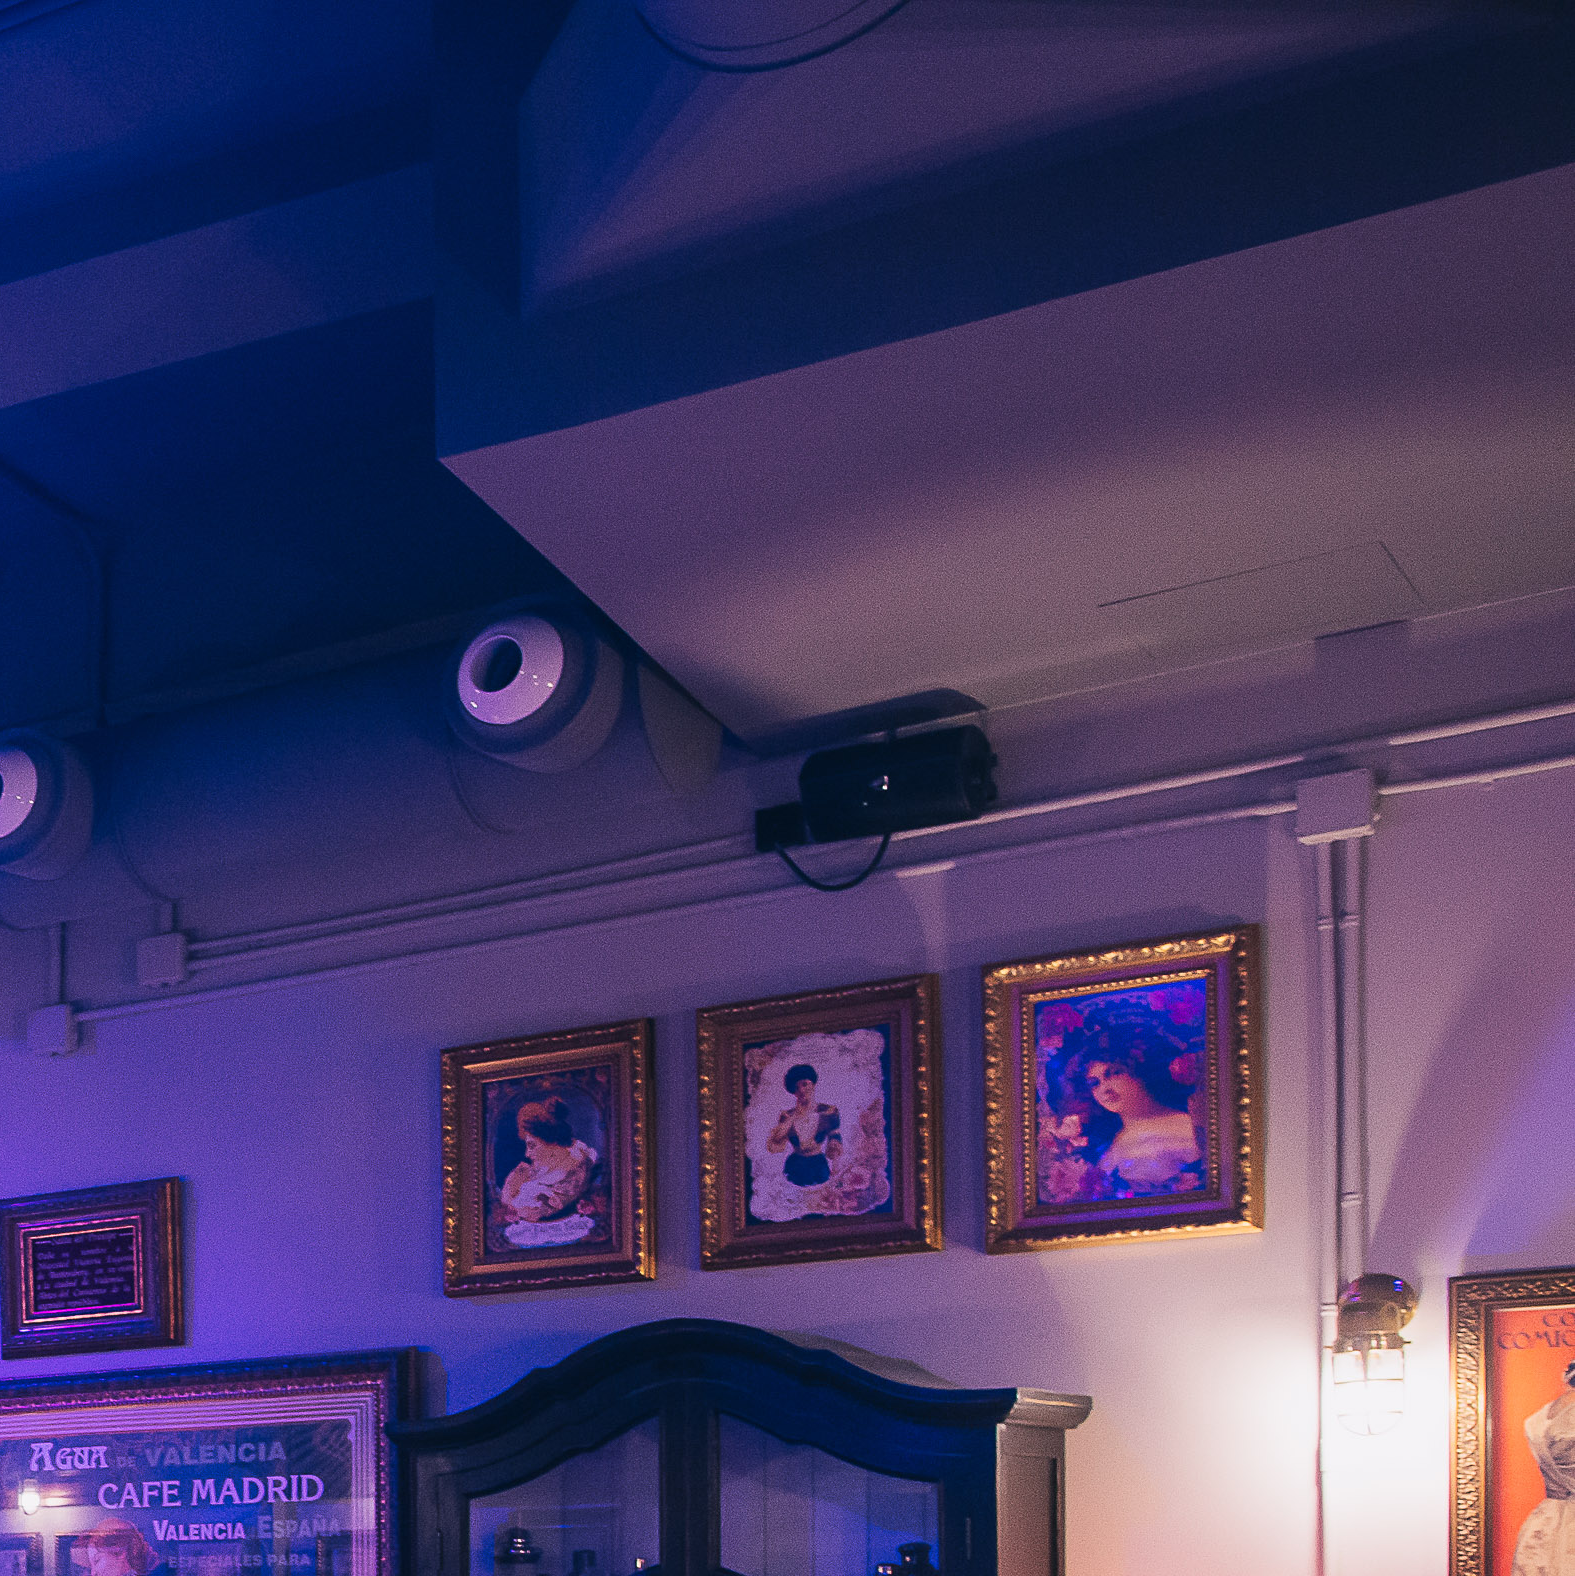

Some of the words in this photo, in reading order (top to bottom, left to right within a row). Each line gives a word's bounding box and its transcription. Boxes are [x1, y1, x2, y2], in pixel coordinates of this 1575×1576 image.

[141, 1441, 288, 1468] VALENCIA
[98, 1480, 183, 1510] CAFE
[190, 1474, 325, 1507] MADRID
[153, 1518, 246, 1542] VALENCIA
[168, 1553, 263, 1569] ESPECIALES
[266, 1553, 312, 1567] PARA
